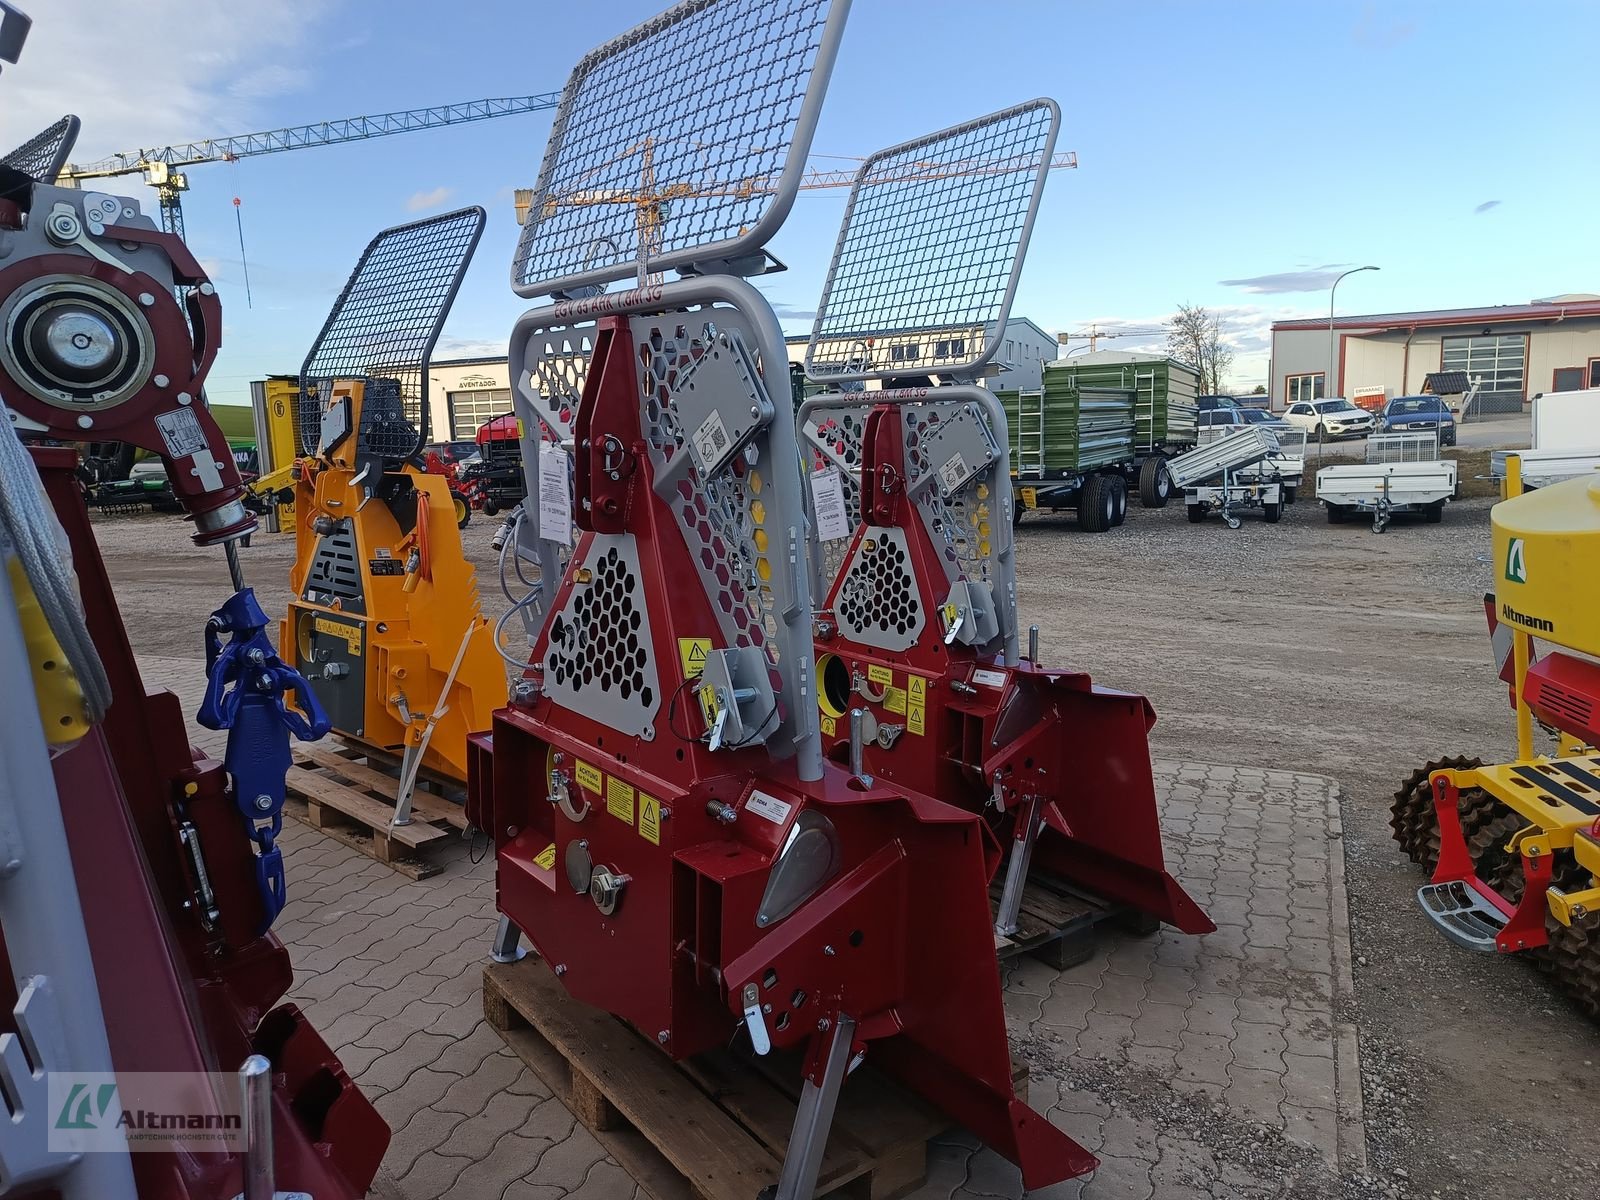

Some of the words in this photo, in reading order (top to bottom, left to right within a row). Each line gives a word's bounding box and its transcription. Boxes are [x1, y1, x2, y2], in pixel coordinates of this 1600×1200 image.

[554, 302, 575, 318] EGV
[591, 294, 614, 313] AHK
[645, 285, 664, 303] SG
[459, 380, 497, 389] AVENTADOR
[843, 391, 860, 402] EGV
[873, 389, 890, 400] AHK
[915, 387, 929, 398] SG
[234, 452, 249, 463] KKA
[1502, 603, 1554, 633] Altmann
[872, 669, 889, 677] ACHTUNG
[579, 767, 598, 781] ACHTUNG
